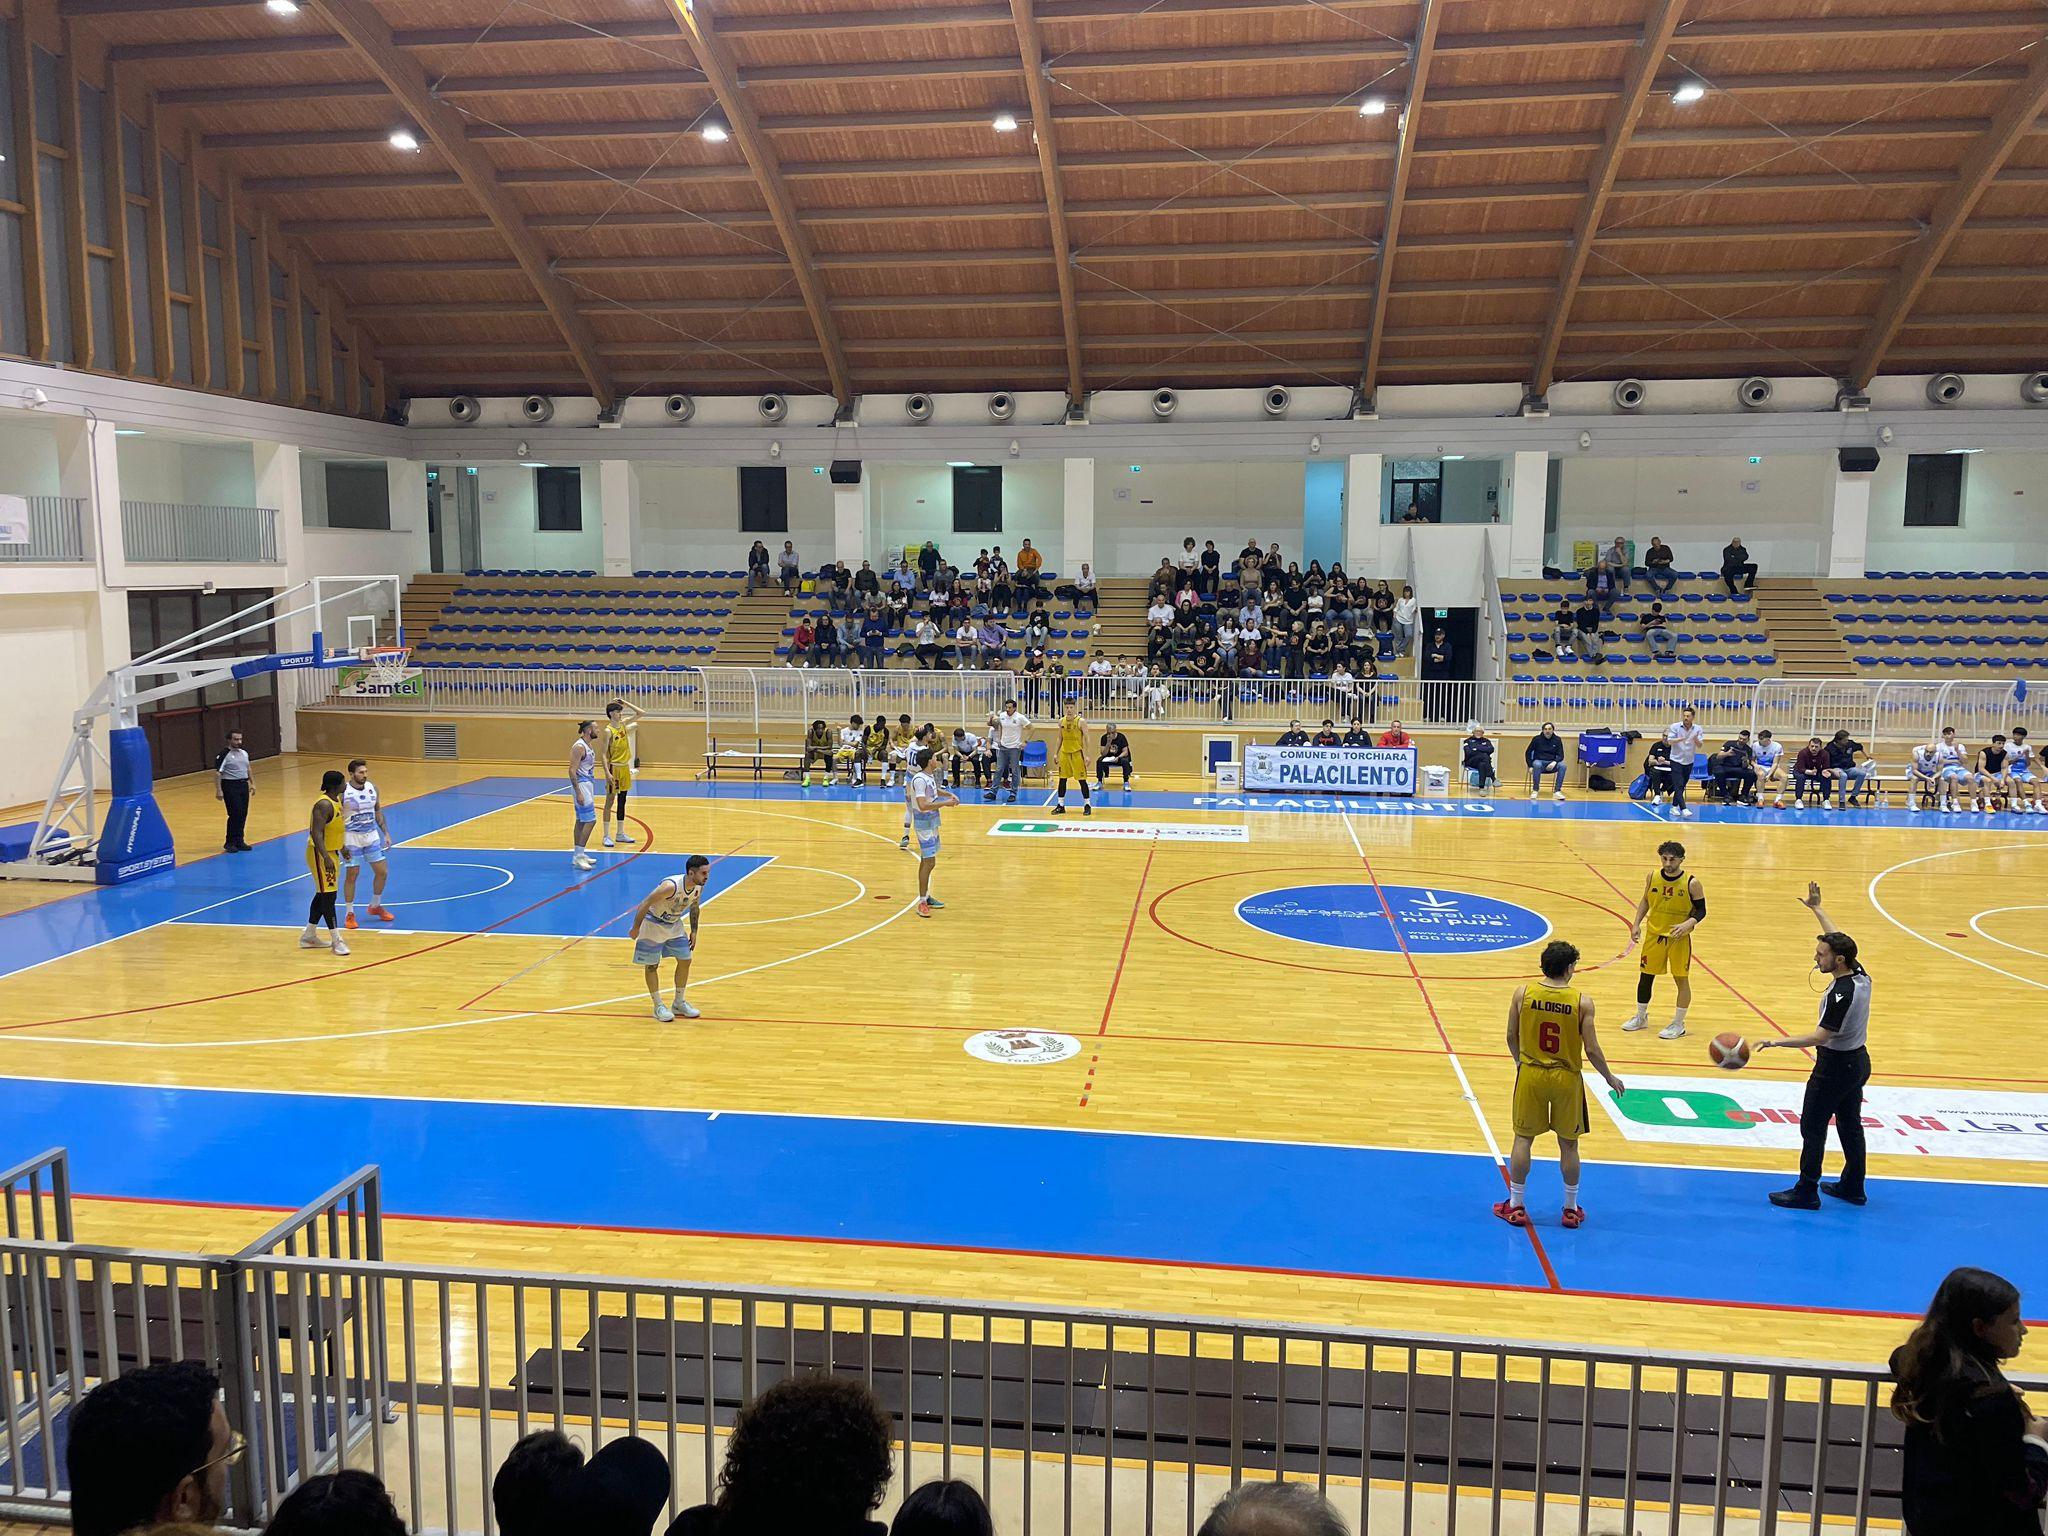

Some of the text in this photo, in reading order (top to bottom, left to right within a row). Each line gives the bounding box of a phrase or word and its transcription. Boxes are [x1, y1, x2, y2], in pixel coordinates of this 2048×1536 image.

[356, 681, 418, 694] Samtel
[1280, 751, 1327, 759] COMUNE
[1344, 752, 1408, 761] TORCHIARA
[1280, 765, 1409, 786] PALACILENTO
[1192, 797, 1496, 812] PALACILENTO
[1662, 885, 1674, 896] 14
[1472, 913, 1510, 921] qui
[1530, 1000, 1572, 1015] ALOISIO
[1539, 1021, 1560, 1054] 6
[1964, 1119, 2023, 1133] La
